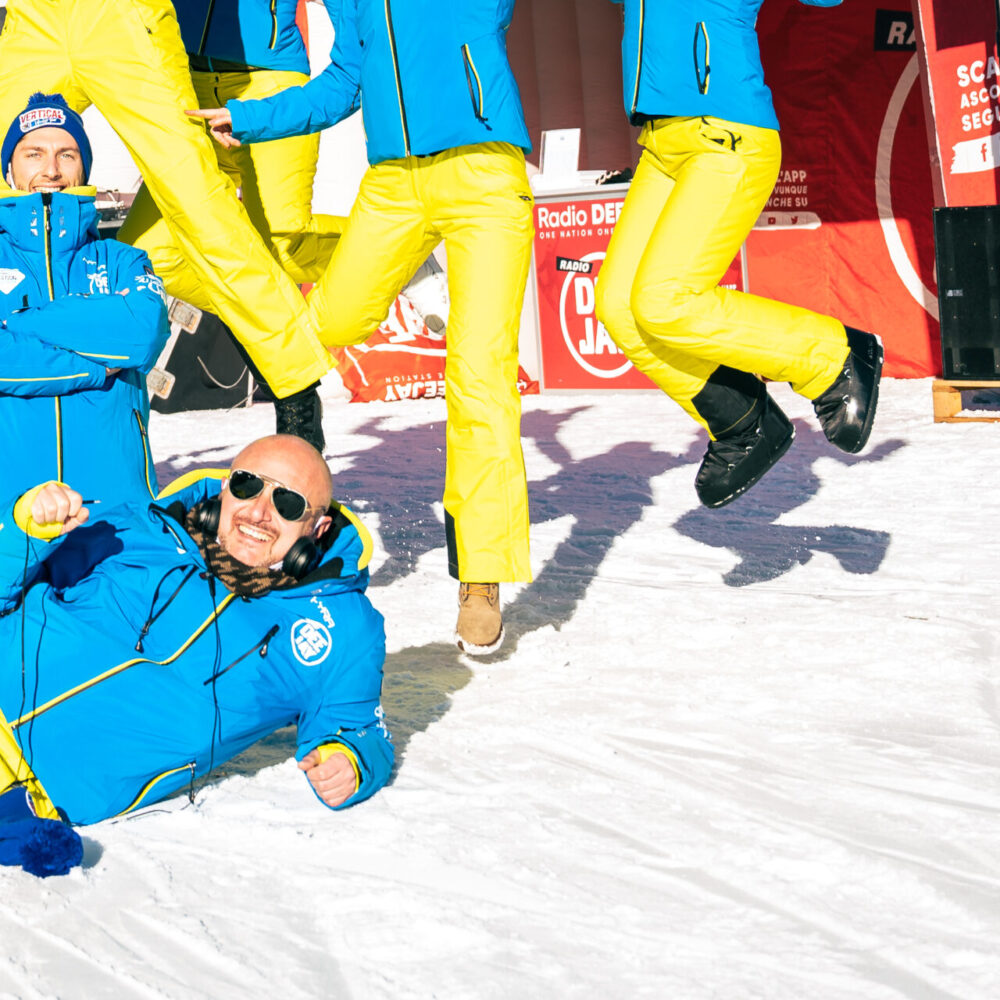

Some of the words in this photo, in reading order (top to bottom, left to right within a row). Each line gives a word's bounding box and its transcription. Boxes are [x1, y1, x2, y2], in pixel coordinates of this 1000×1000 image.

[20, 109, 64, 123] VERTICAL
[774, 185, 808, 195] VUNQUE
[794, 197, 808, 207] SU
[538, 204, 588, 229] Radio
[591, 201, 625, 226] DEE
[539, 231, 556, 239] ONE
[560, 229, 593, 238] NATION
[560, 259, 590, 273] RADIO
[385, 380, 446, 401] EEJAY
